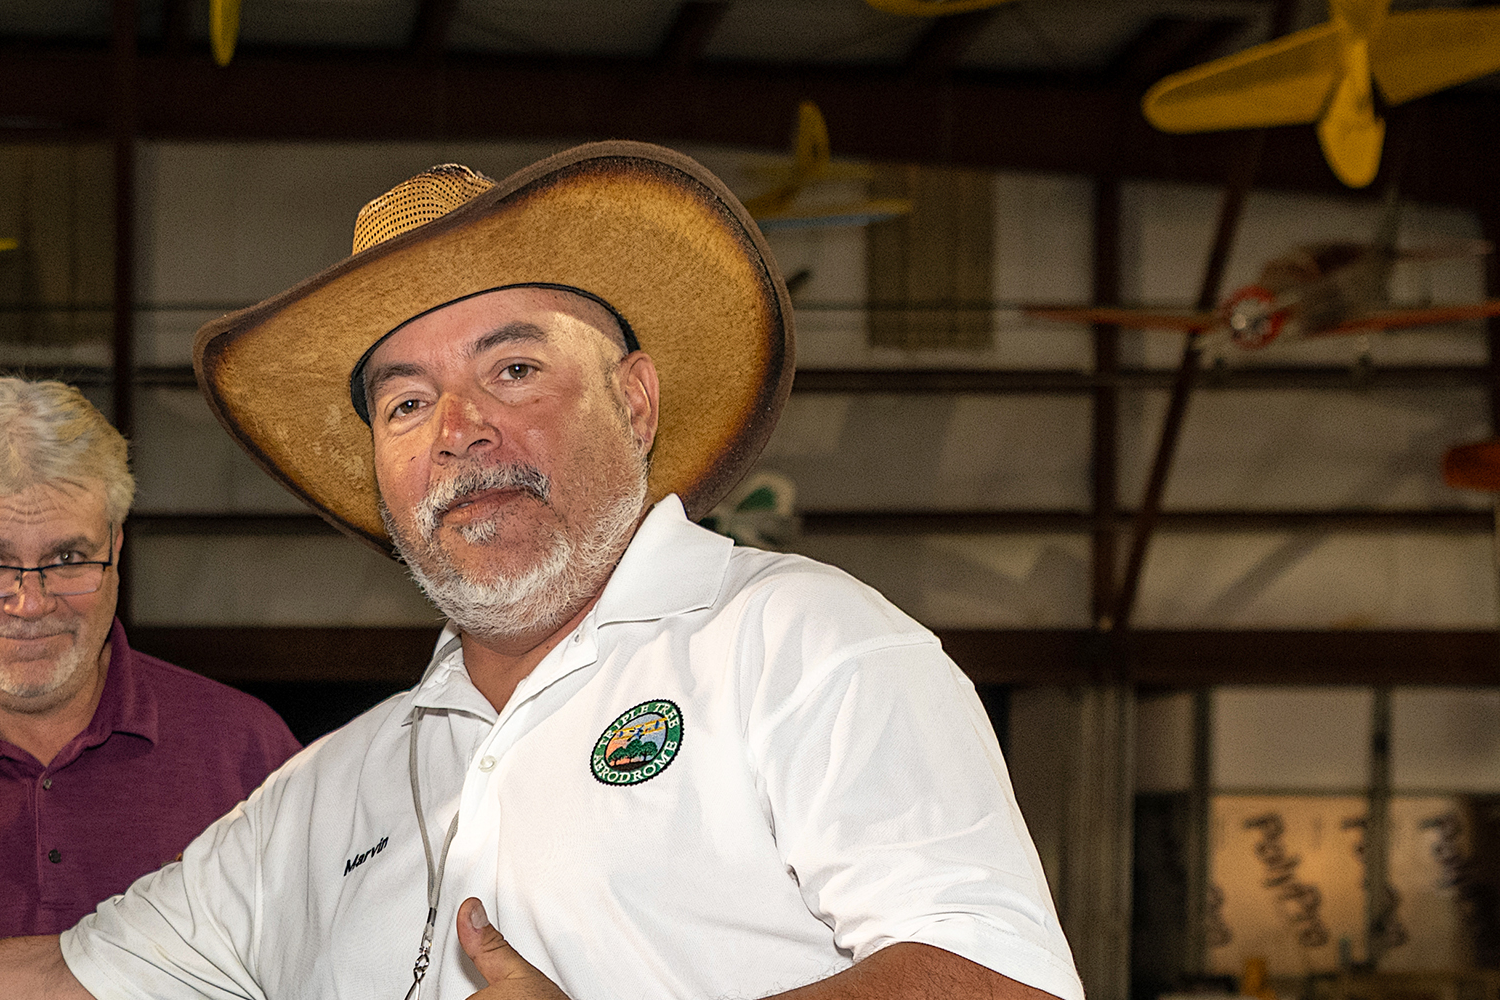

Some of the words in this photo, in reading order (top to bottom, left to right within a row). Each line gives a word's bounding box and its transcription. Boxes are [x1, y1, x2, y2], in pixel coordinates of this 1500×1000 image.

[597, 704, 650, 749] TRIPLE
[653, 702, 680, 729] TREE
[593, 740, 678, 783] AERODROME
[343, 836, 389, 877] Marvin
